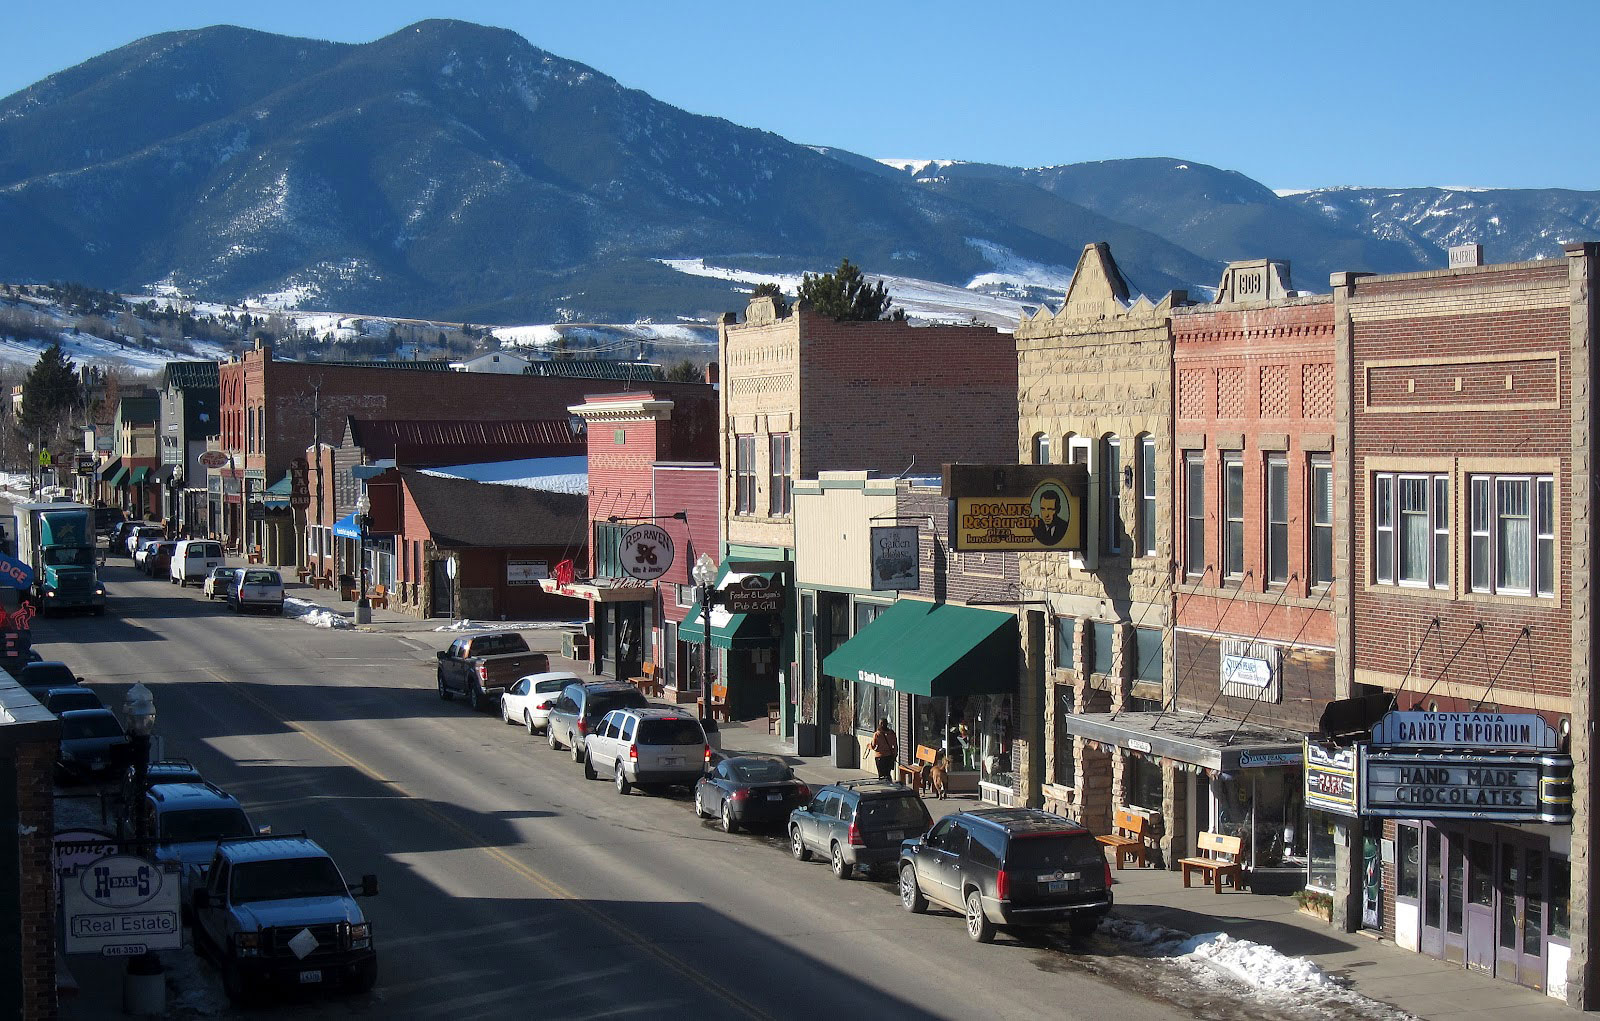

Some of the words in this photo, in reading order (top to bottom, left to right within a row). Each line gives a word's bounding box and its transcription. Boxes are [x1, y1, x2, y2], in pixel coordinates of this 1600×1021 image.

[1450, 249, 1476, 264] MAJERUS
[1239, 273, 1261, 294] 1908
[970, 502, 1033, 516] BOGARTS
[962, 514, 1041, 529] Restaurant
[986, 527, 1012, 536] pizza
[624, 530, 642, 552] RED
[643, 529, 670, 552] RAVEN
[879, 537, 911, 549] Garden
[0, 560, 28, 584] DGE
[734, 601, 750, 610] Pub
[760, 601, 777, 611] Grill
[1423, 713, 1505, 723] MONTANA
[1399, 721, 1447, 742] CANDY
[1454, 722, 1530, 743] EMPORIUM
[1400, 767, 1450, 786] HAND
[1467, 768, 1518, 787] MADE
[1395, 786, 1523, 806] CHOCOLATES
[80, 917, 116, 933] Real
[121, 915, 171, 931] Estate
